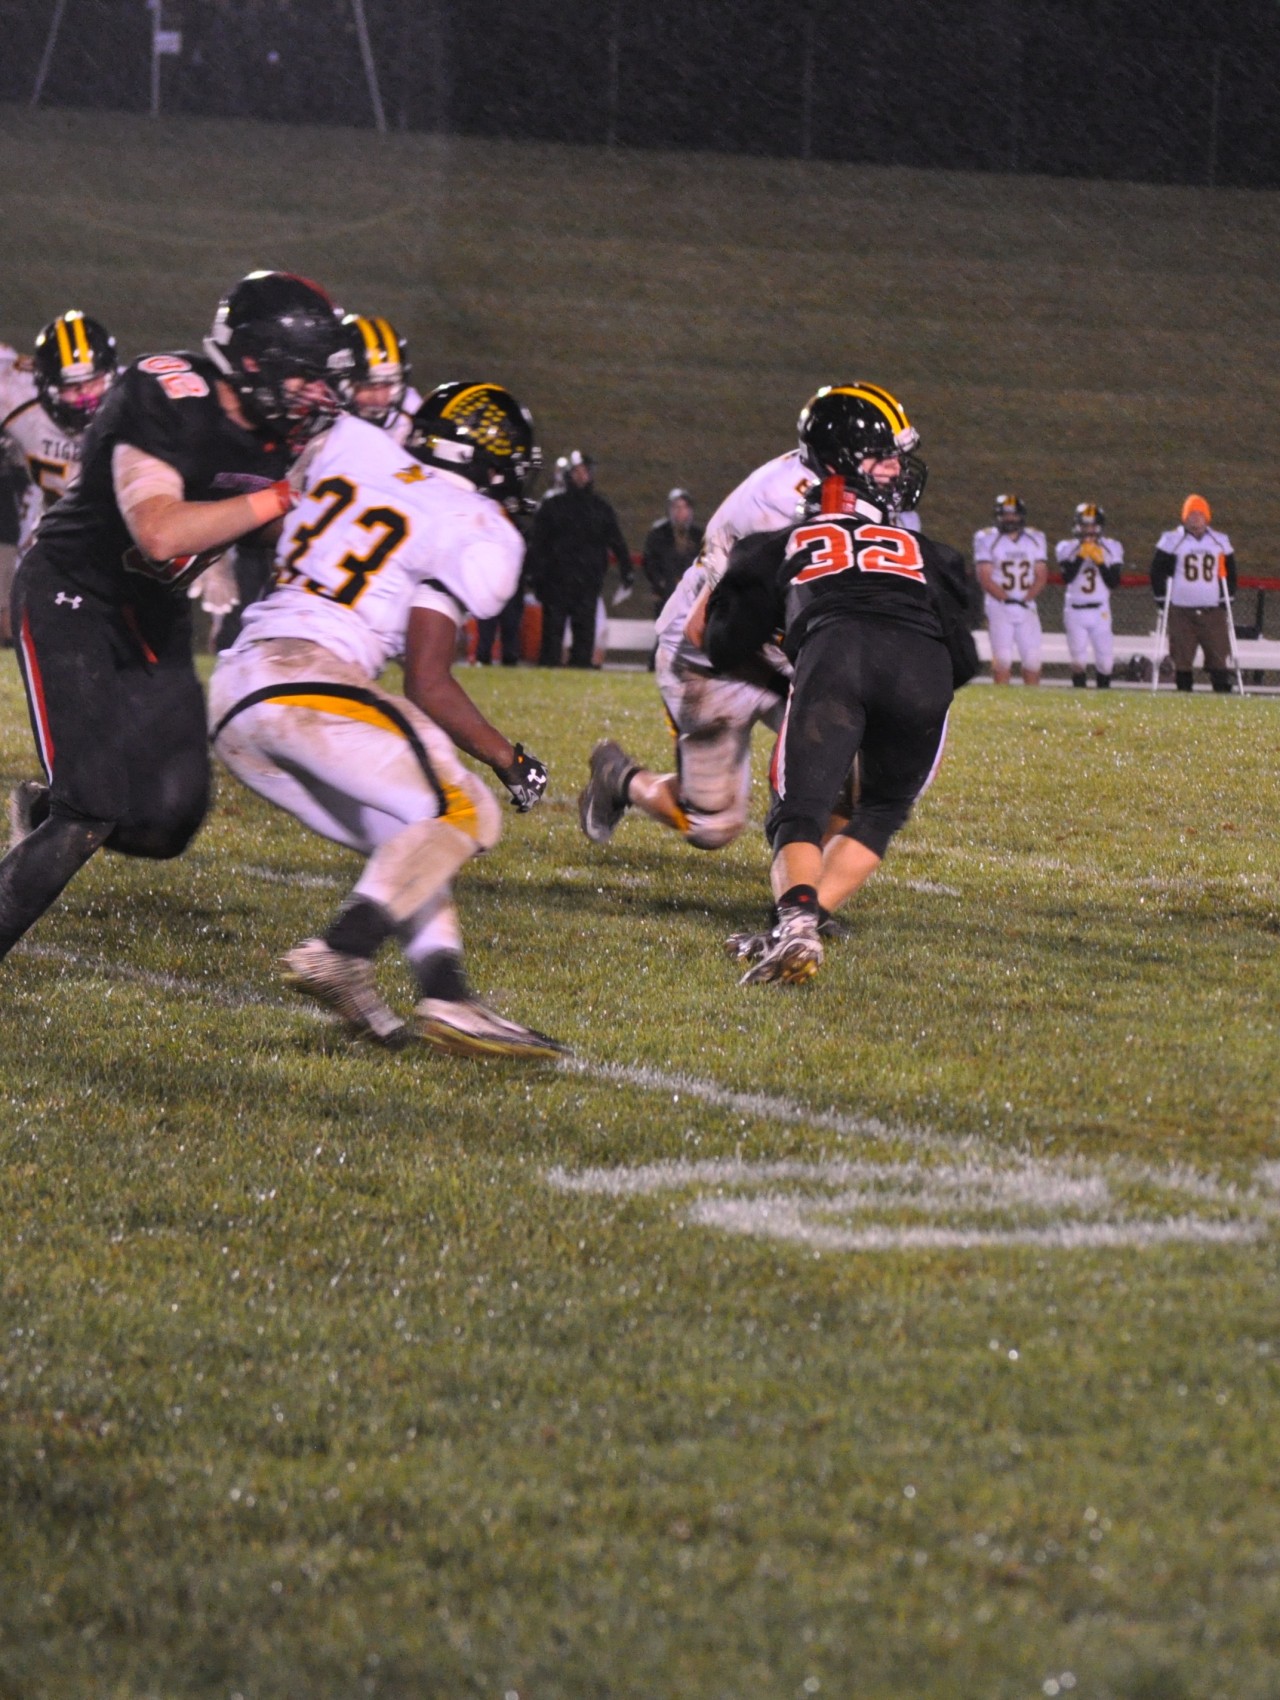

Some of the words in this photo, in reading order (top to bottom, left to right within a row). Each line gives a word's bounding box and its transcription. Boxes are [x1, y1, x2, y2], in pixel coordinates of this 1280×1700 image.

[784, 522, 928, 585] 32
[1183, 553, 1215, 582] 68
[1001, 561, 1031, 591] 52
[1081, 567, 1097, 595] 3
